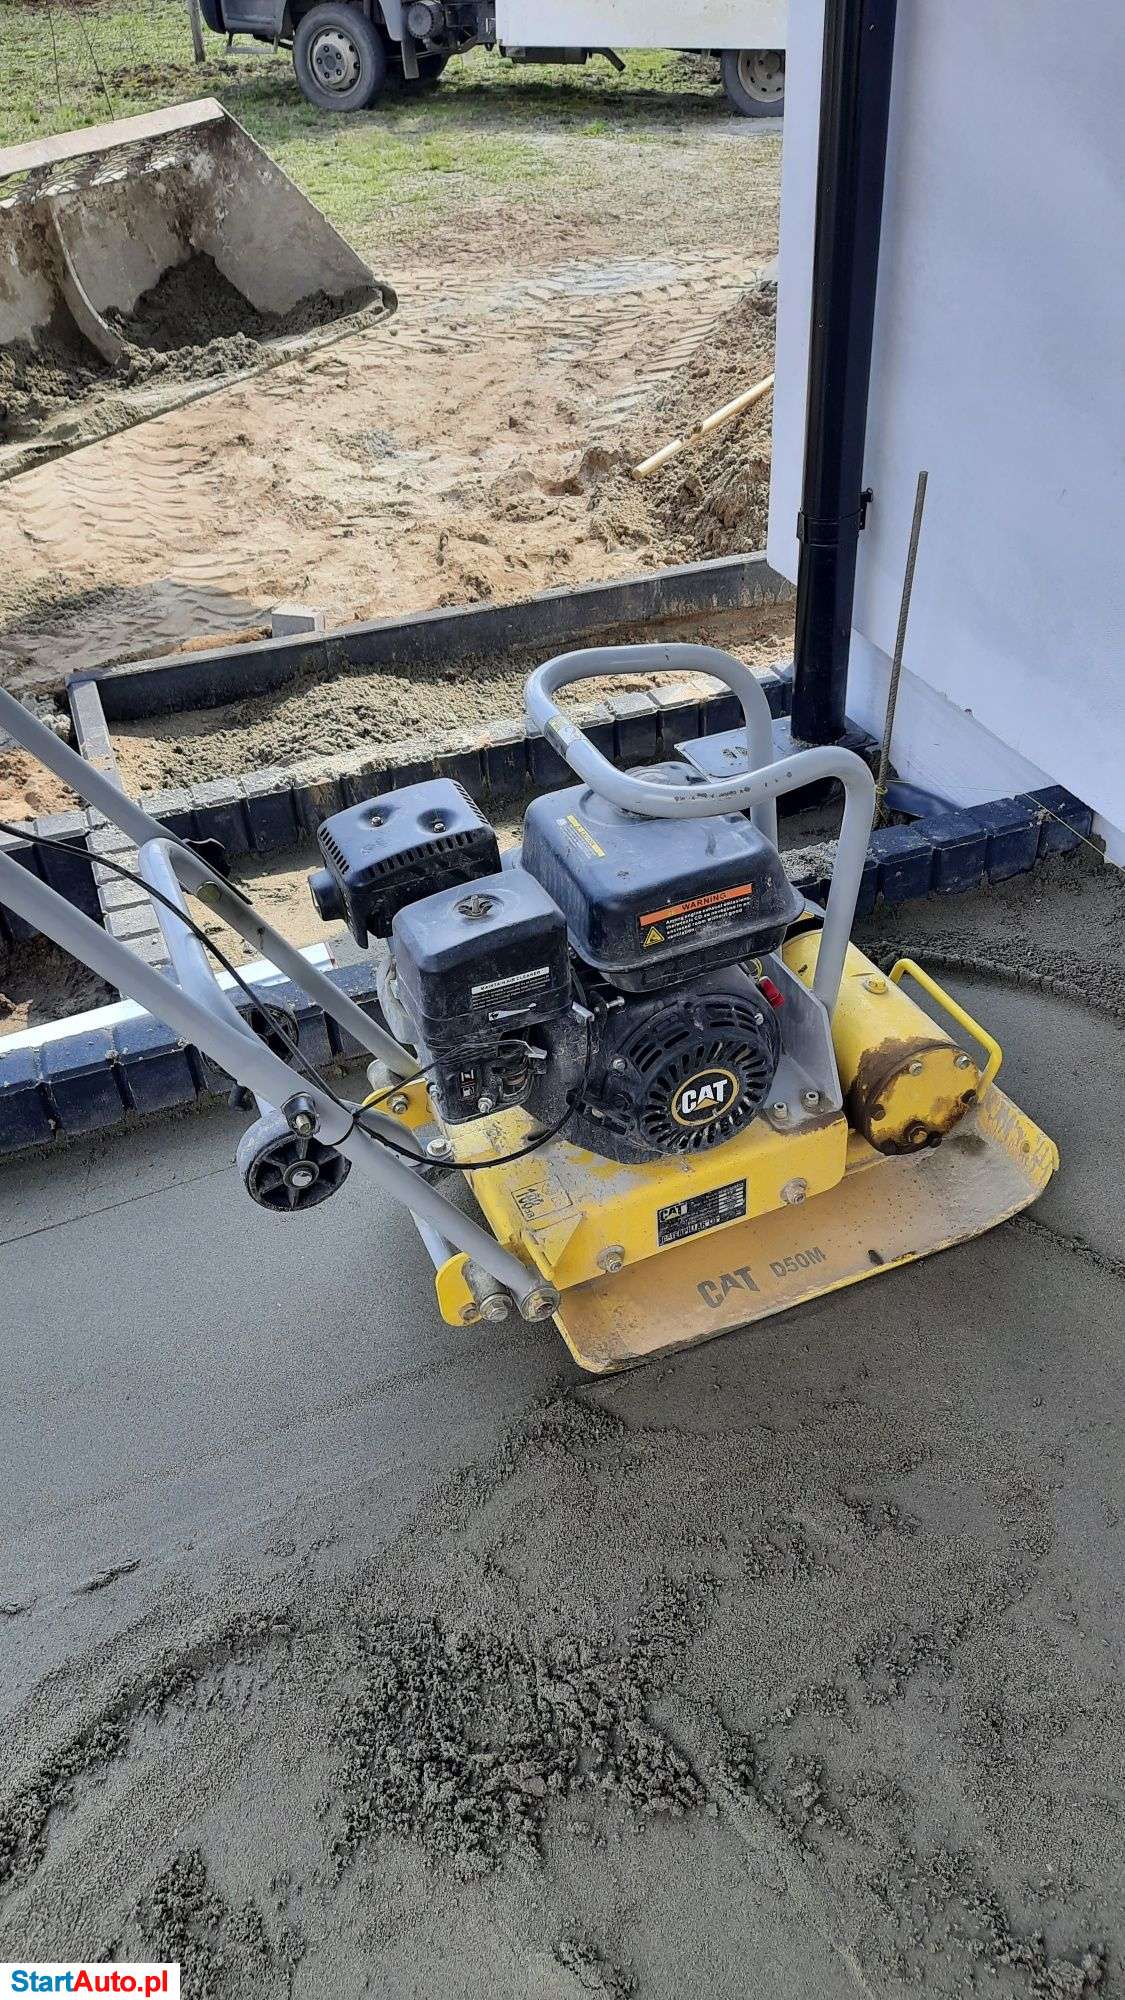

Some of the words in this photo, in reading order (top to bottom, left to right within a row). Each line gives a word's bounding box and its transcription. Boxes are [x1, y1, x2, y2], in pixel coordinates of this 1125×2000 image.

[681, 892, 726, 911] WARNING
[681, 1079, 728, 1114] CAT
[696, 1266, 760, 1309] CAT
[769, 1246, 827, 1278] D50M
